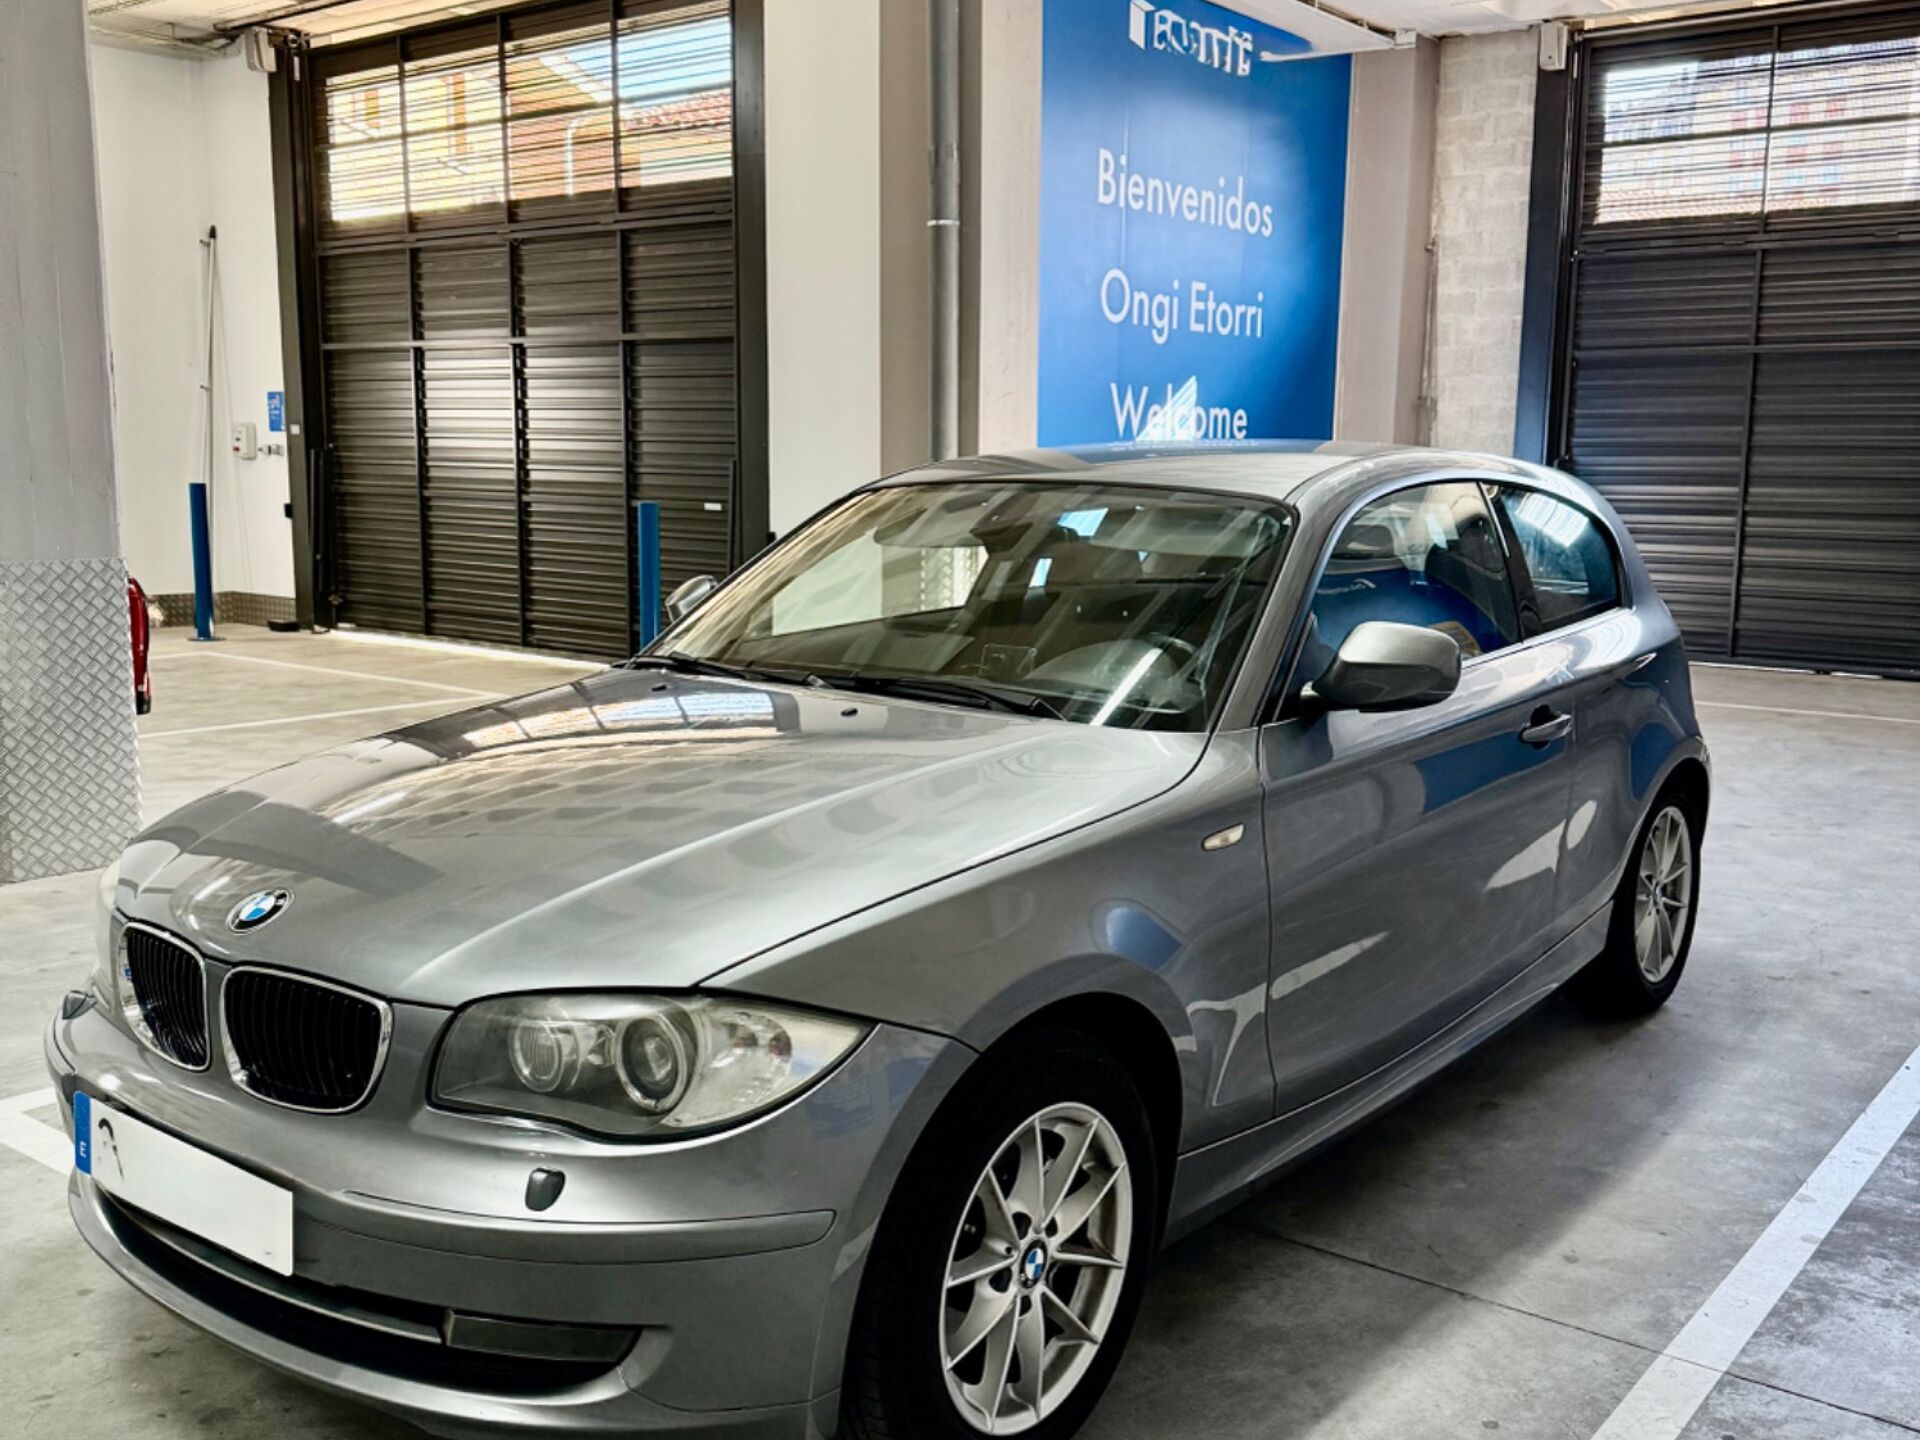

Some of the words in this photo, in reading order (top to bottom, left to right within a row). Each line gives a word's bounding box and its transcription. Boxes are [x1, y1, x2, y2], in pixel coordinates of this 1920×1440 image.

[1098, 148, 1273, 237] Bienvenidos
[1101, 269, 1179, 344] Ongi
[1189, 281, 1263, 338] Etorri
[79, 1140, 87, 1158] E
